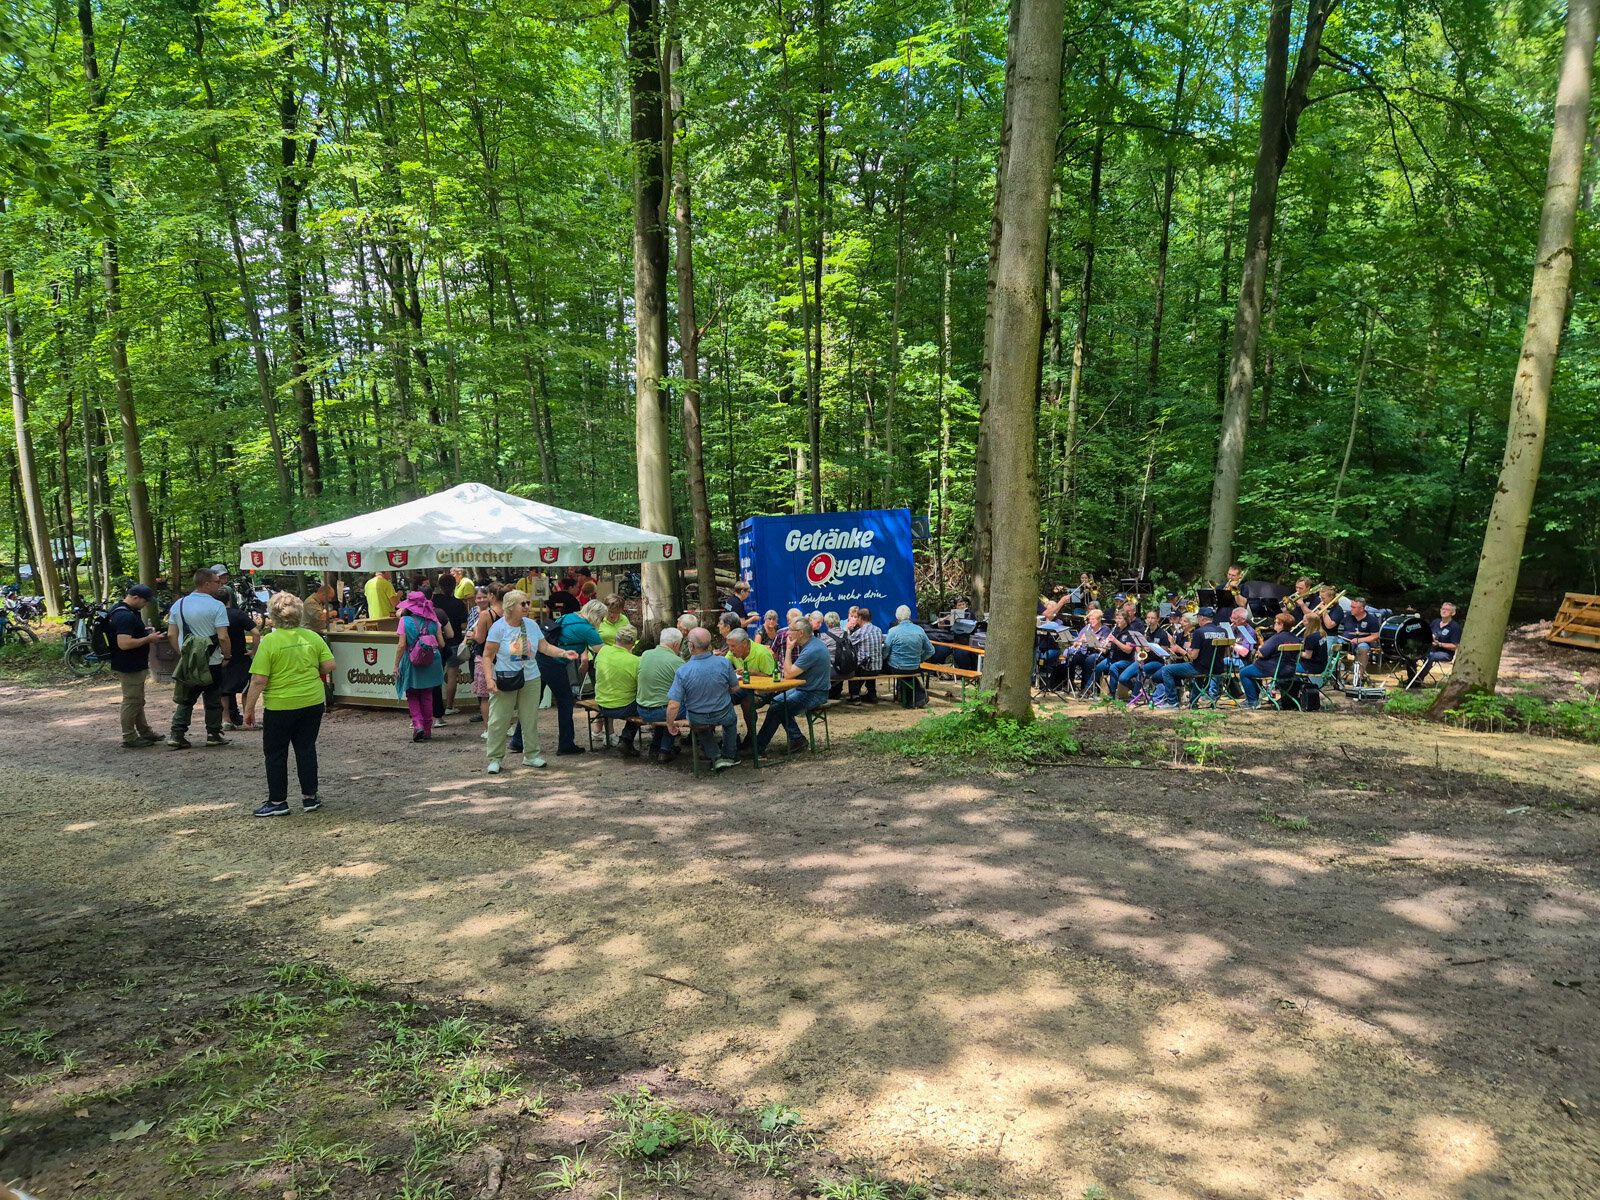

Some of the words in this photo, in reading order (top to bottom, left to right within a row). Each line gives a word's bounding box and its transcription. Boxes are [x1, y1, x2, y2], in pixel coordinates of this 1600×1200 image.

[785, 527, 874, 552] Getränke
[280, 551, 329, 567] Einbecker
[435, 548, 513, 564] Einbecker
[608, 546, 649, 562] Einbecker
[837, 588, 862, 601] mehr
[863, 588, 888, 599] drin
